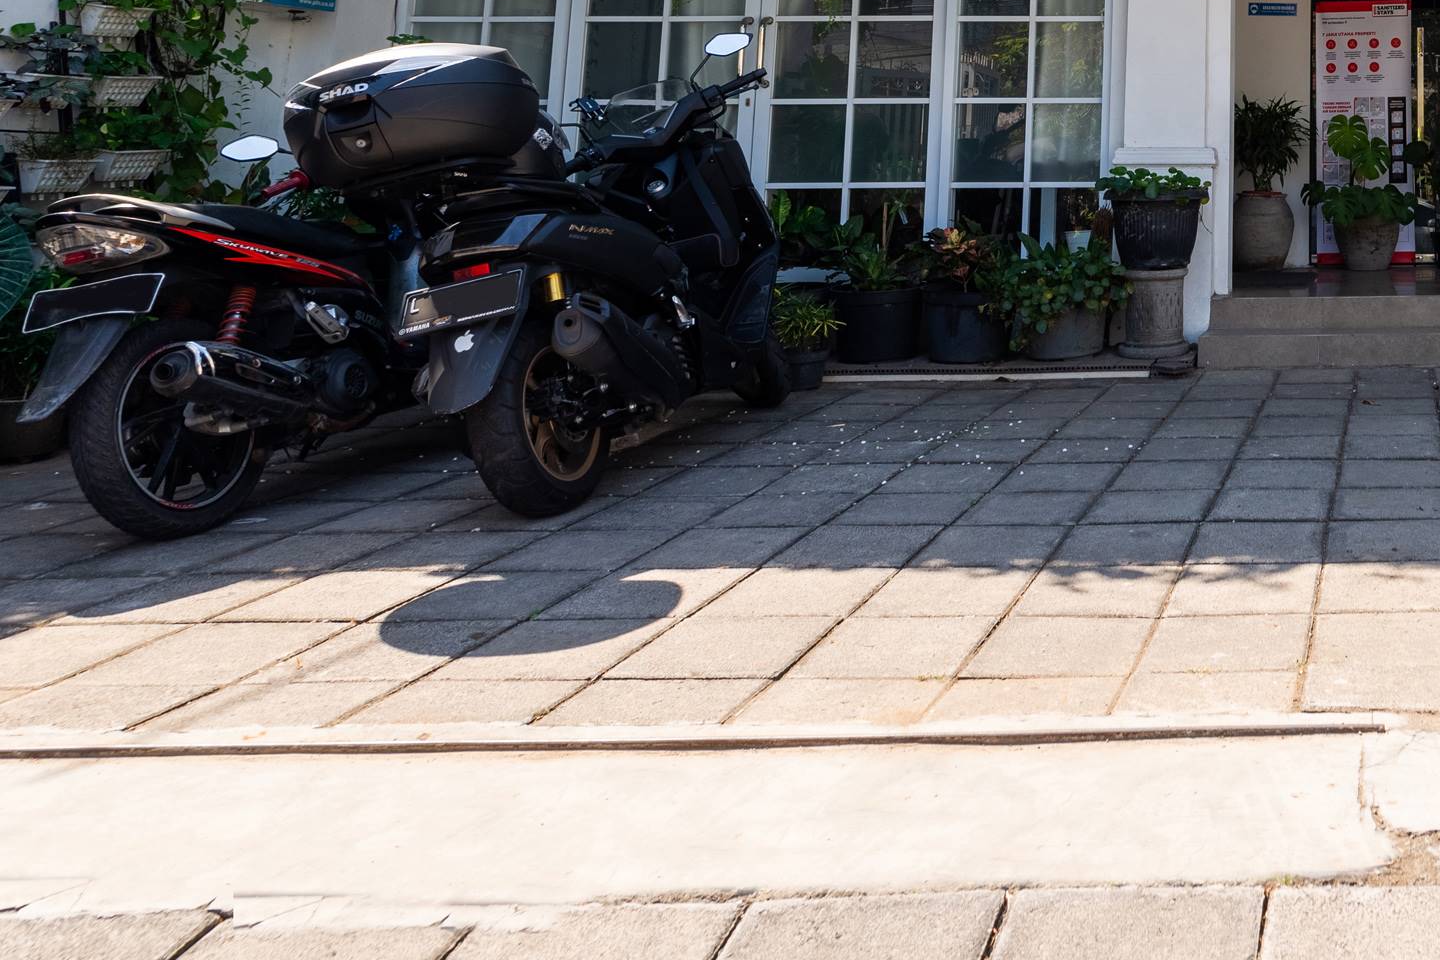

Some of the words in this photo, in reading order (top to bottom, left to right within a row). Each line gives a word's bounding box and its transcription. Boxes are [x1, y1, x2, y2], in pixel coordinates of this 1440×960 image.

[319, 82, 369, 102] SHAD
[409, 297, 420, 314] L
[405, 322, 430, 334] YAMAHA
